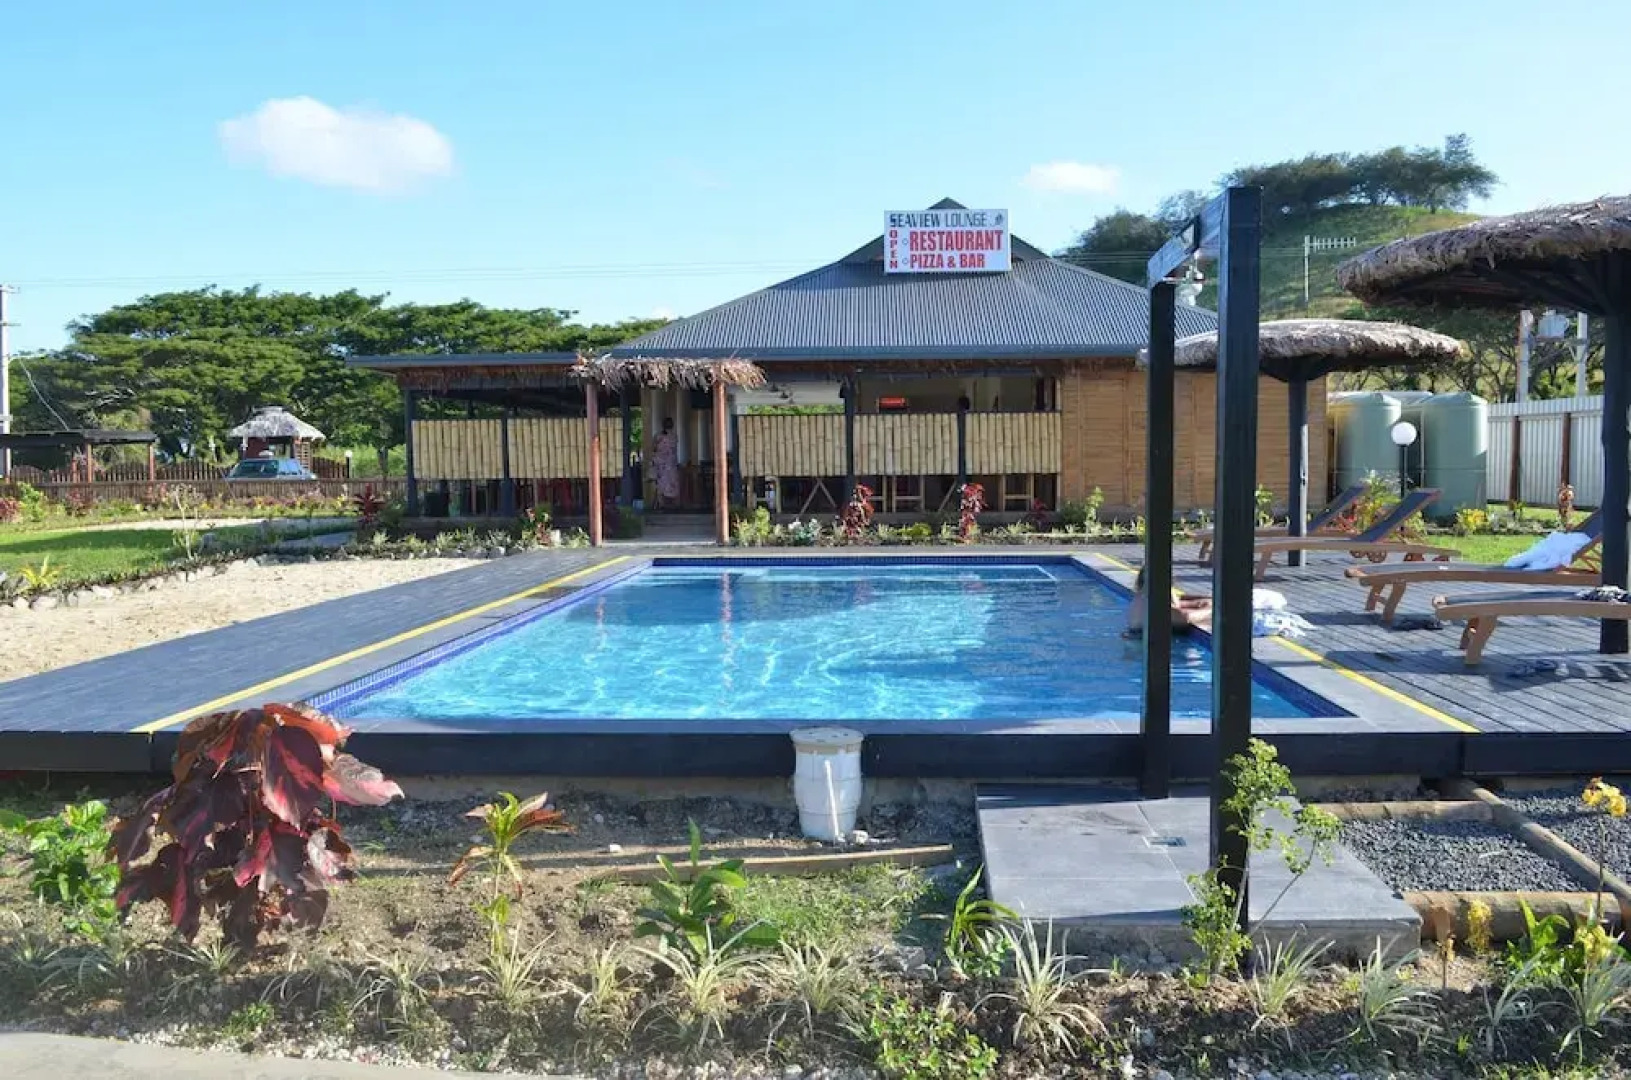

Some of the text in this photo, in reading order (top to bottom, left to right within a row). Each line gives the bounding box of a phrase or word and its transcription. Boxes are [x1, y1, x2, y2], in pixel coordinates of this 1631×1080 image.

[890, 212, 987, 227] SEAVIEW LOUNGE
[889, 229, 898, 269] OPEN
[910, 230, 1003, 251] RESTAURANT
[910, 253, 985, 268] PIZZA & BAR
